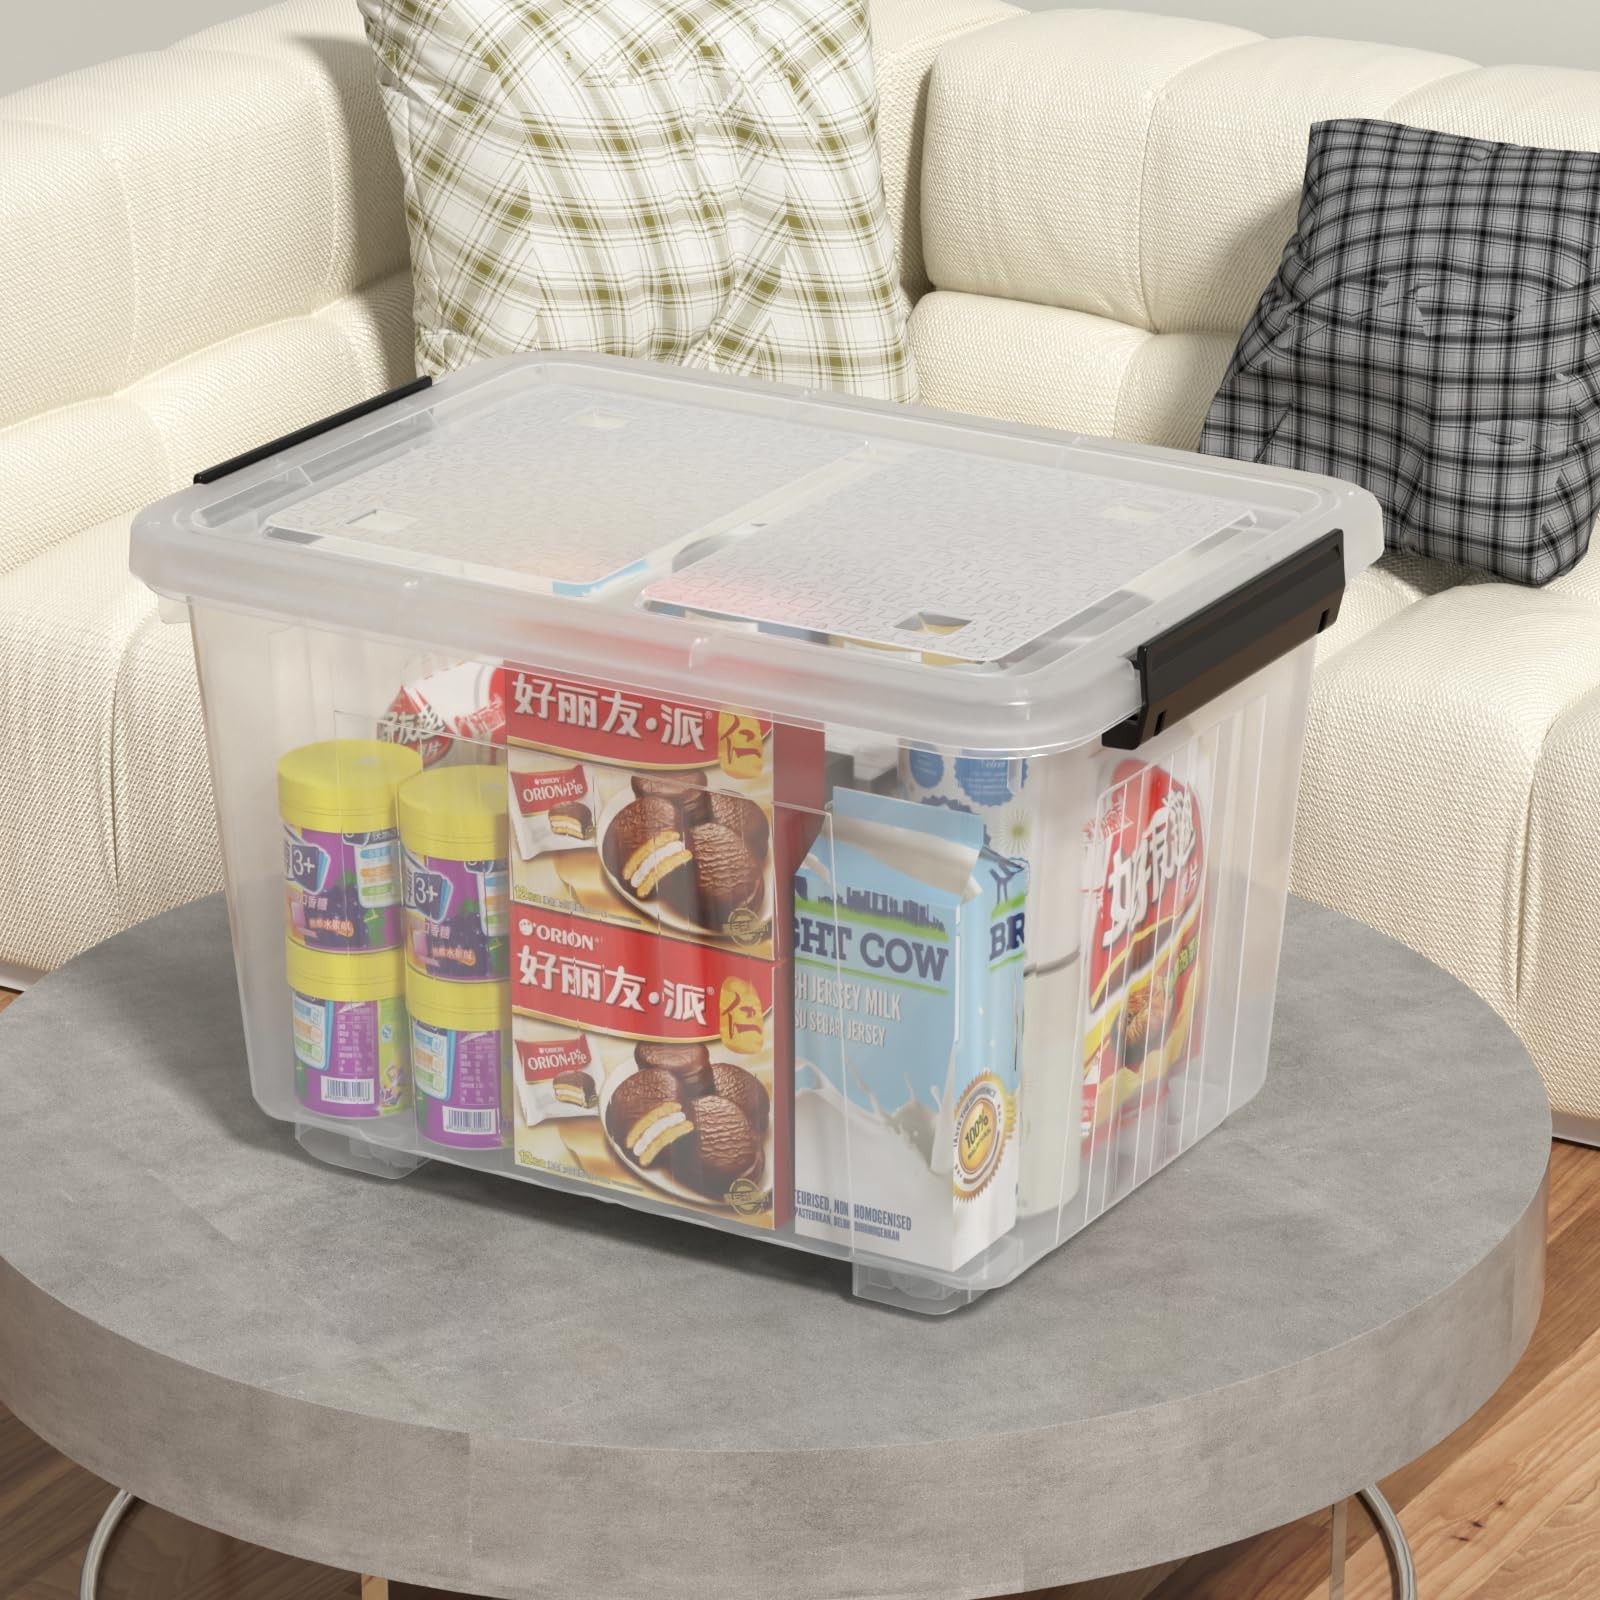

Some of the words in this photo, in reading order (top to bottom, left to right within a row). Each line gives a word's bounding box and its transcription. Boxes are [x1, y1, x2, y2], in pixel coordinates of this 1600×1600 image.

[720, 713, 762, 765] 仁
[293, 850, 315, 876] 3+
[415, 877, 438, 903] 3+
[537, 921, 595, 951] ORION
[989, 912, 1025, 961] BR
[860, 932, 949, 982] COW
[722, 992, 762, 1039] 仁
[811, 976, 861, 1012] JERSEY
[865, 988, 902, 1022] MILK
[848, 1019, 886, 1048] JERSEY
[965, 1108, 990, 1149] 100%
[834, 1200, 849, 1217] NON
[854, 1203, 912, 1232] HOMOGENISED
